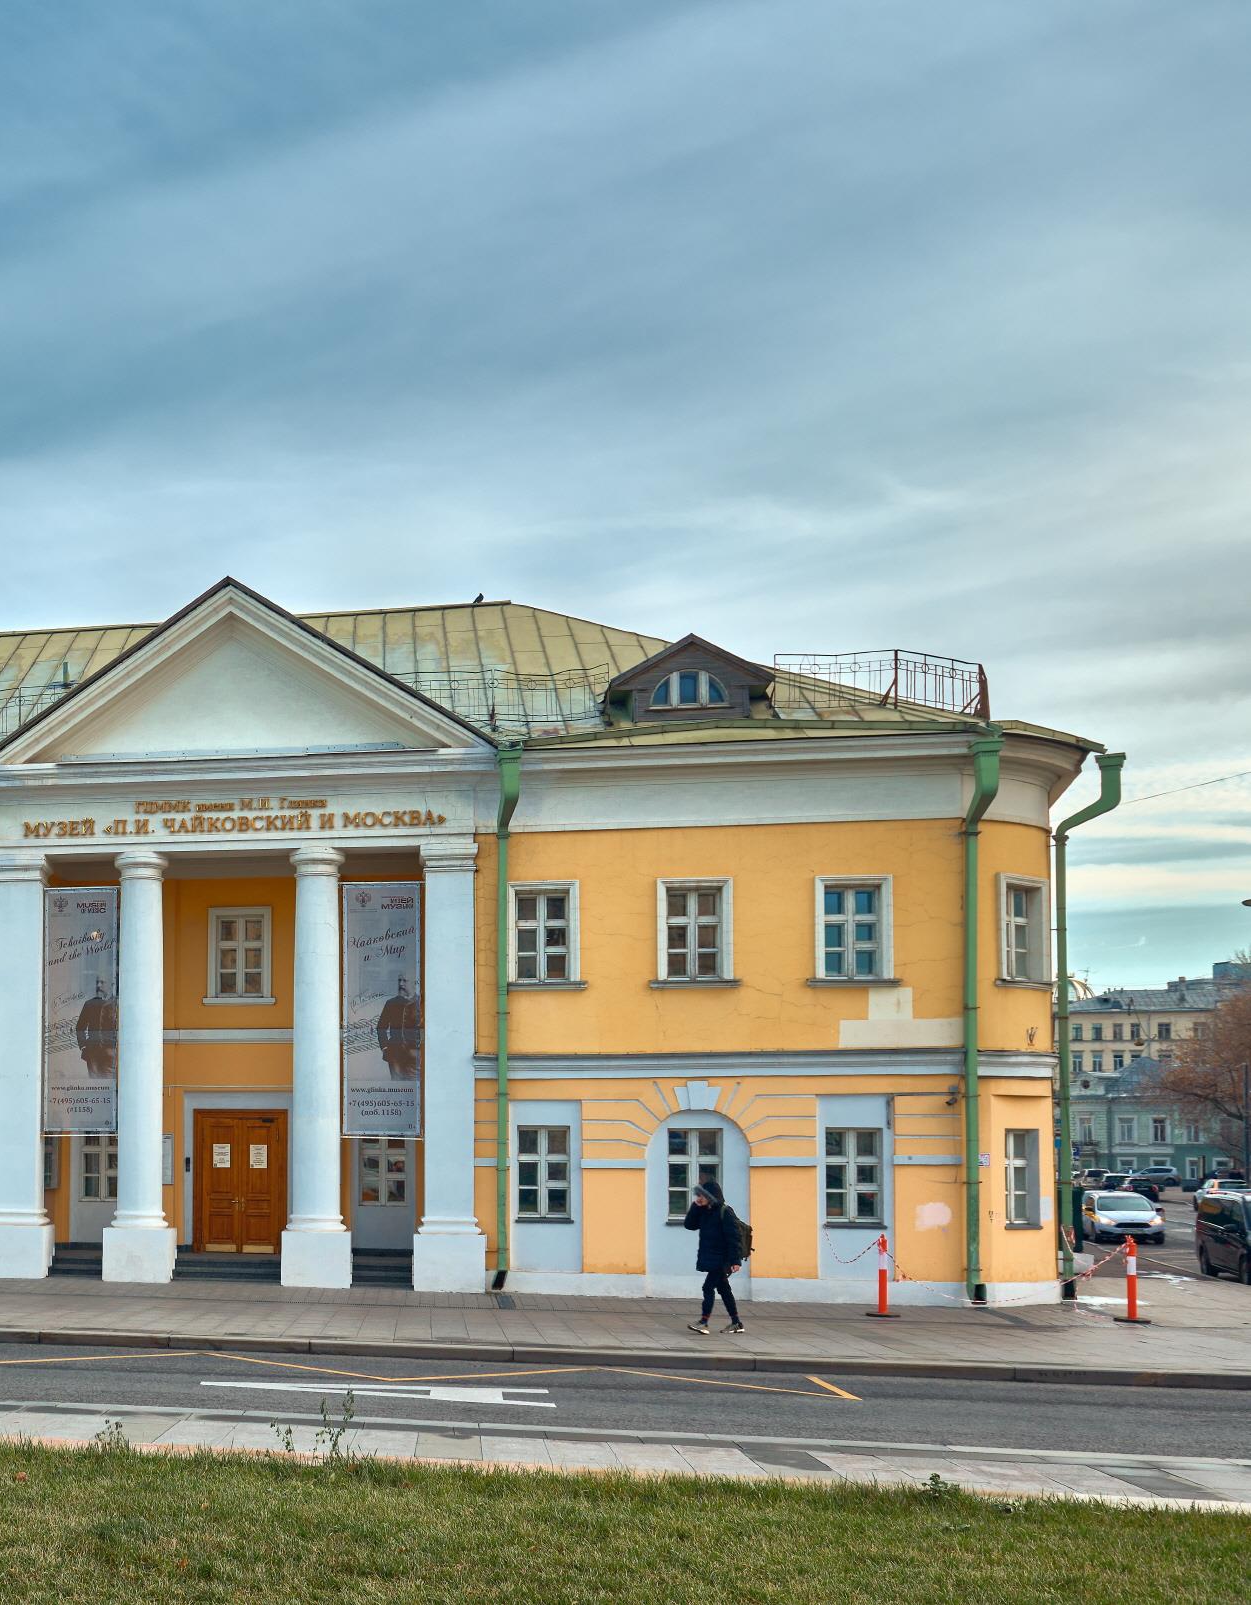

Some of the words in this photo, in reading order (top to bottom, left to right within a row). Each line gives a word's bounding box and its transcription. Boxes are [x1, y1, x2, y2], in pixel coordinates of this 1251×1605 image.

[23, 818, 96, 837] МУЗЕЙ
[162, 811, 312, 833] ЧАЙКОВСКИЙ
[319, 813, 335, 829] И
[343, 809, 447, 828] МОСКВА»
